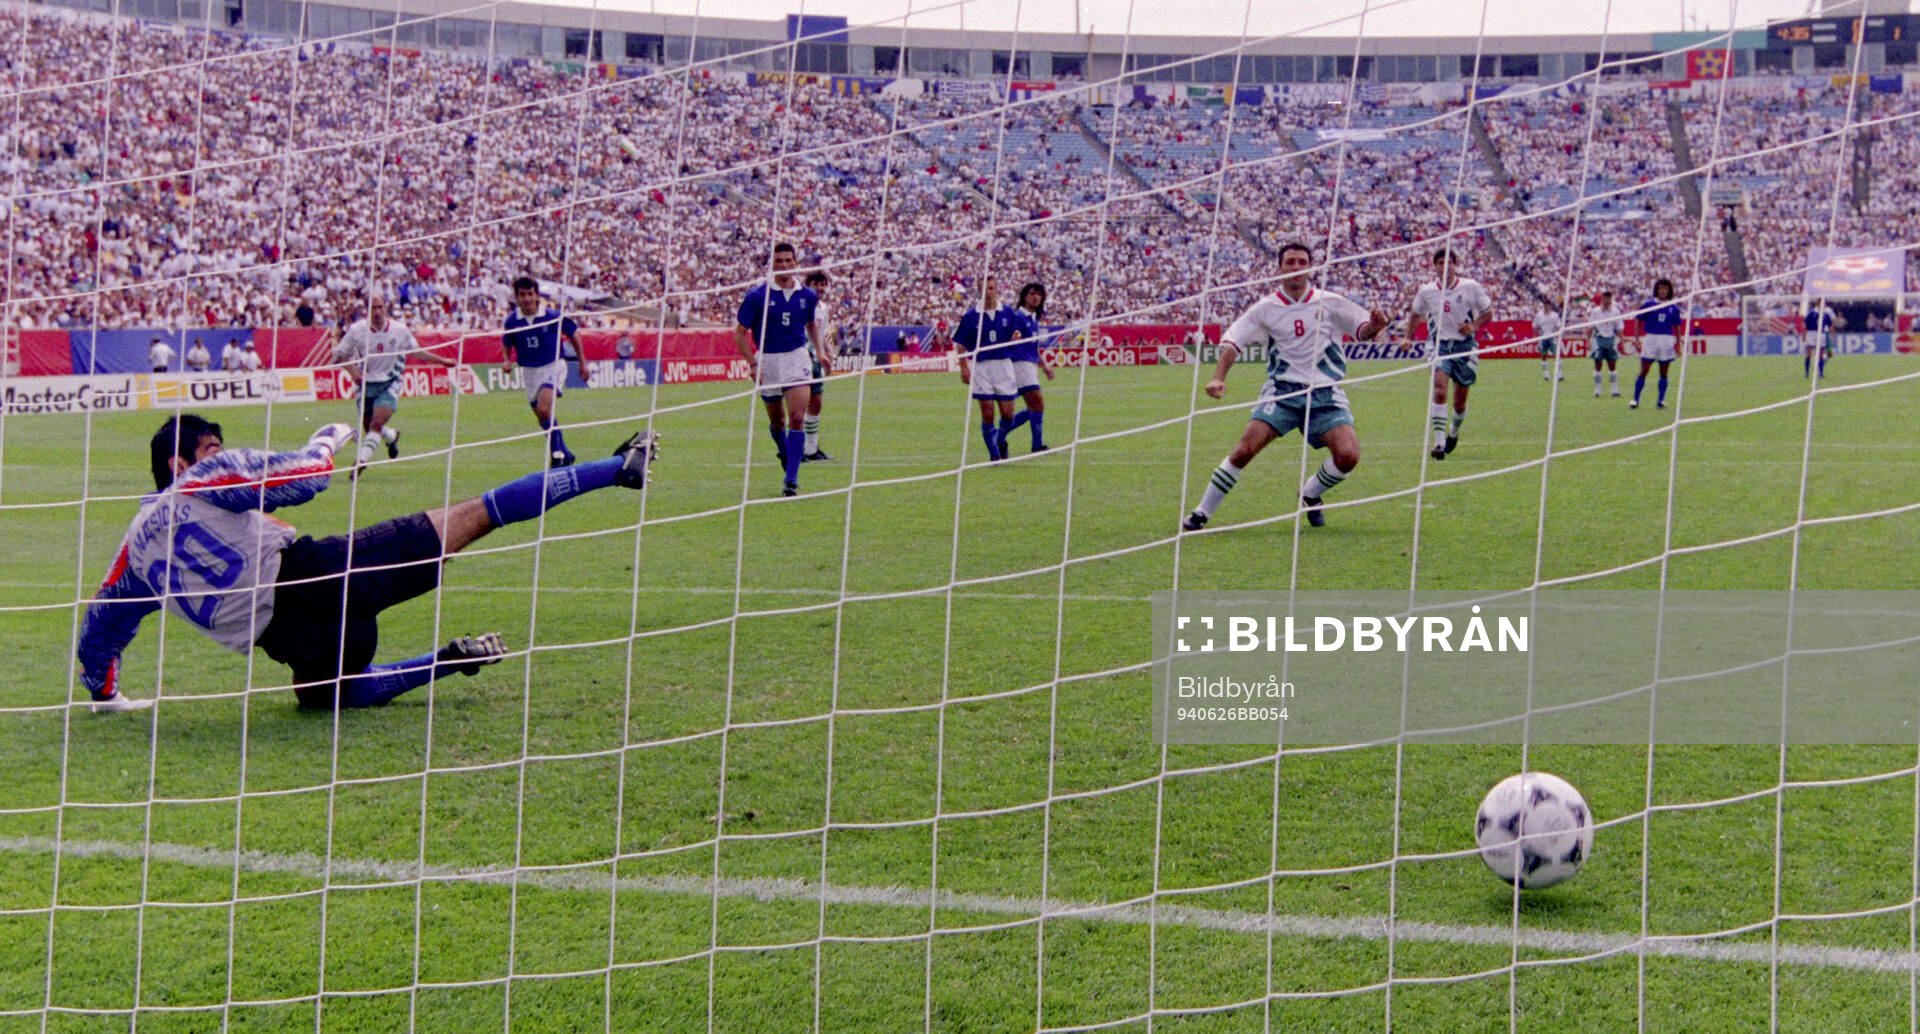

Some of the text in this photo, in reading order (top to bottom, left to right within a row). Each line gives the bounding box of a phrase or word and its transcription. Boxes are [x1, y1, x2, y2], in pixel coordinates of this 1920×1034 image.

[781, 312, 791, 326] 5
[1294, 319, 1304, 337] 8
[526, 336, 539, 348] 13
[1342, 342, 1426, 360] ICKERS
[587, 360, 647, 388] Gillette
[665, 361, 689, 382] JVC
[727, 359, 751, 379] JVC
[191, 379, 262, 401] OPEL
[147, 521, 248, 630] 20
